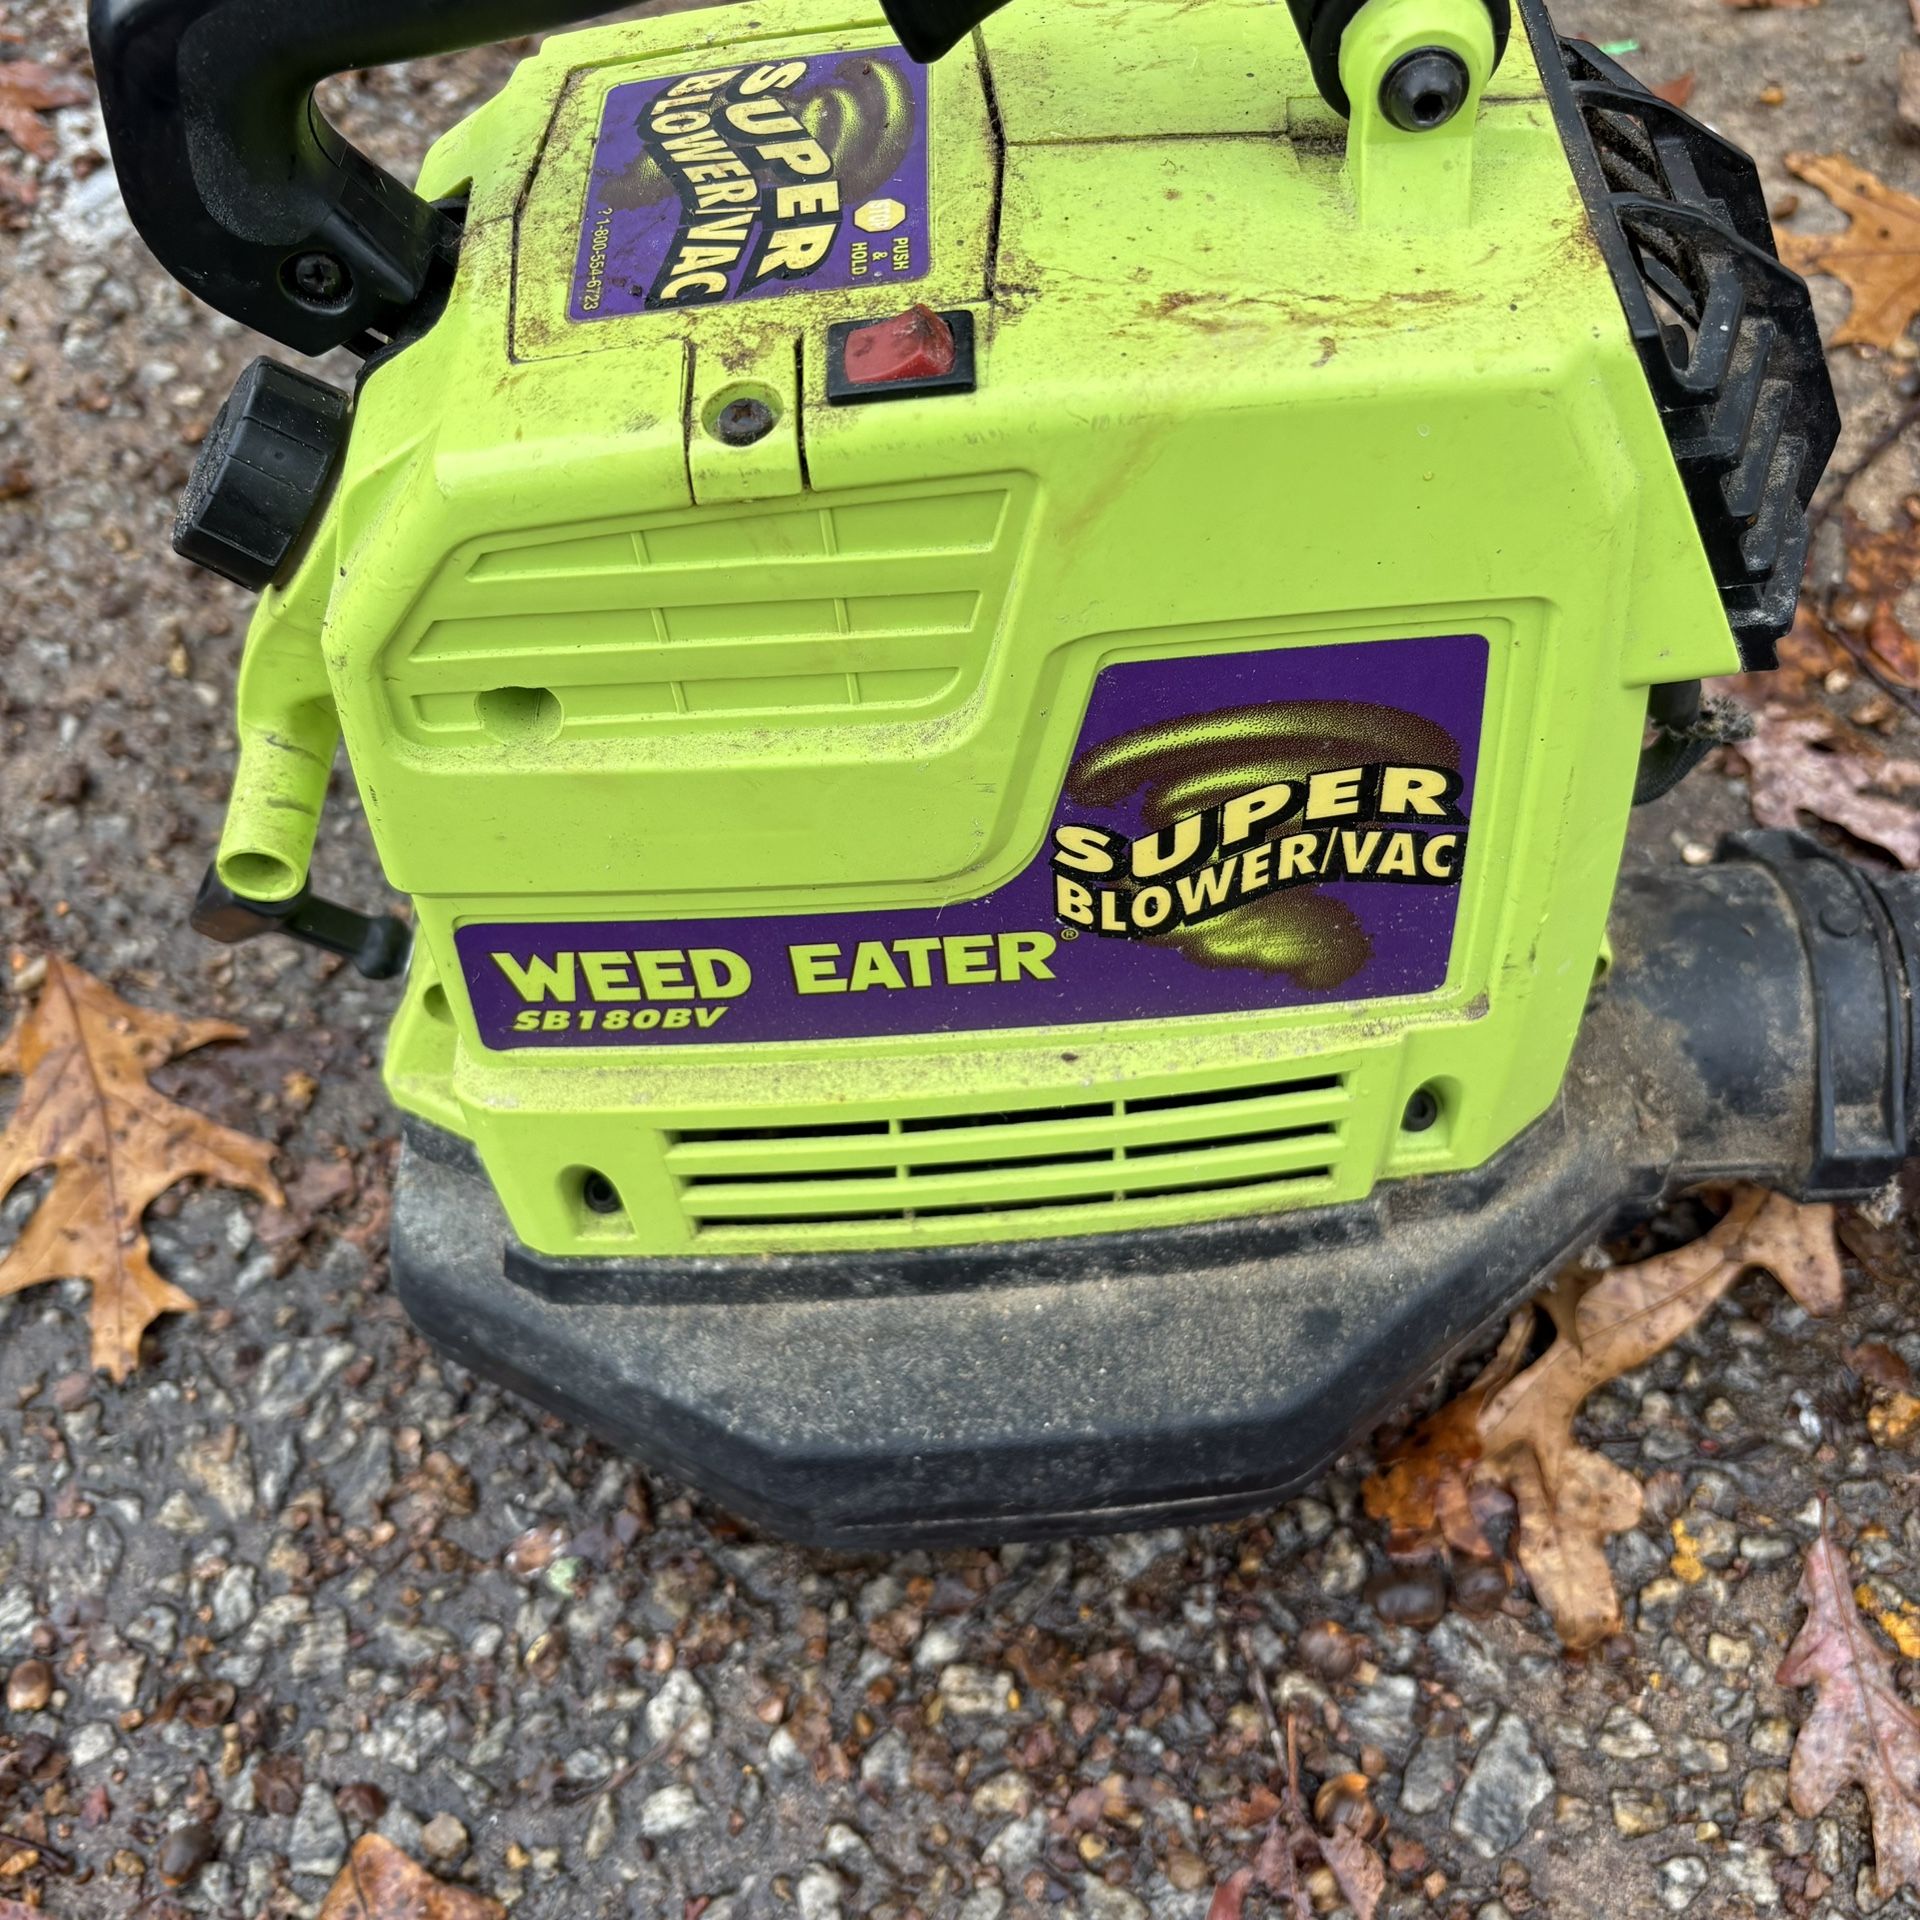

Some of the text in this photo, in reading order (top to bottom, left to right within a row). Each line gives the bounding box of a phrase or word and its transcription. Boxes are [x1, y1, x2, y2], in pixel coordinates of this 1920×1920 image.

[650, 69, 761, 300] BLOWER/VAC
[725, 61, 840, 279] SUPER
[583, 218, 611, 311] 1-800-554-6723
[851, 242, 868, 275] HOLD
[872, 251, 888, 261] &
[893, 237, 909, 271] PUSH
[1054, 766, 1448, 879] SUPER
[1056, 826, 1458, 932] BLOWER/VAC
[490, 948, 752, 1002] WEED
[512, 1006, 730, 1032] SB180BV
